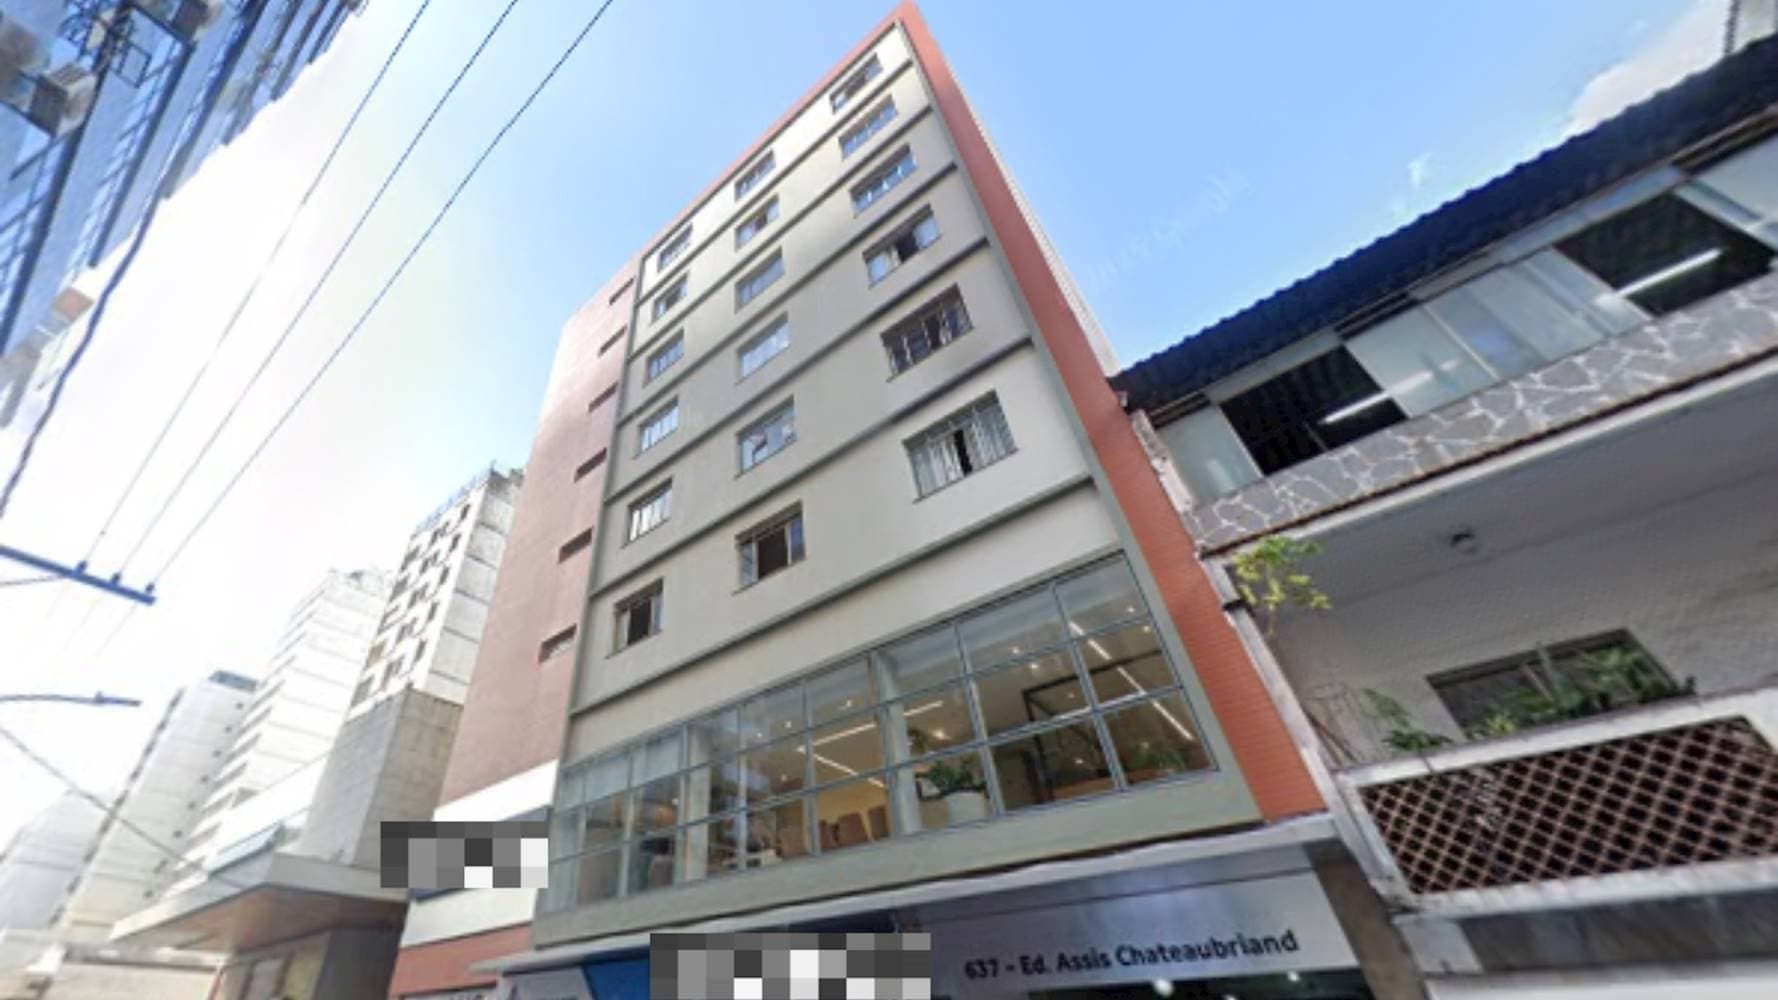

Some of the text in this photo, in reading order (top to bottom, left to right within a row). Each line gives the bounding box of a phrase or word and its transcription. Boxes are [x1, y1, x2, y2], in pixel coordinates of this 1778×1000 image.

[964, 958, 999, 980] 637
[1019, 954, 1051, 977] Ed.
[1057, 947, 1112, 973] Assis
[1115, 929, 1299, 967] Chateaubriand
